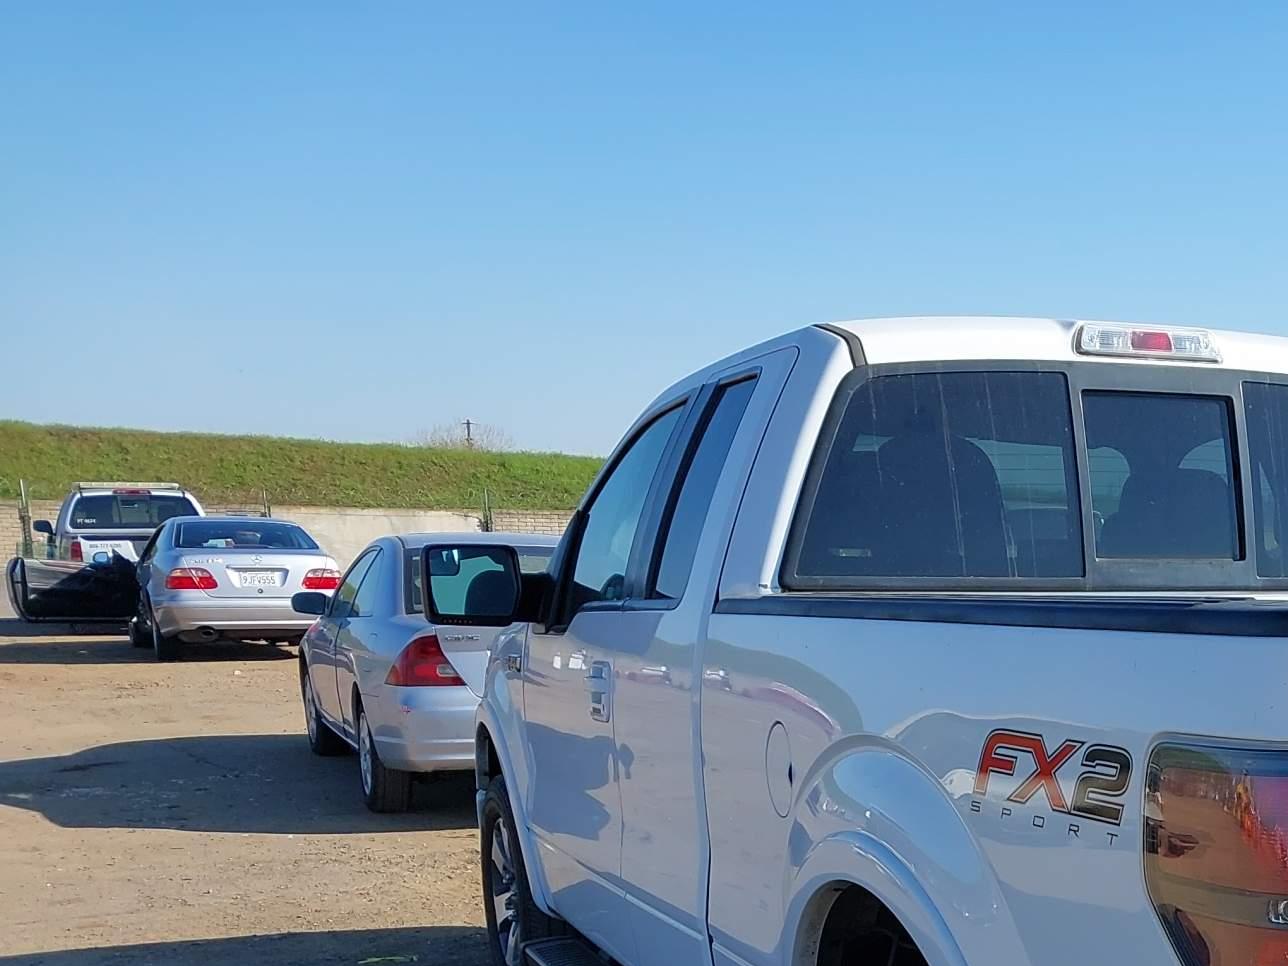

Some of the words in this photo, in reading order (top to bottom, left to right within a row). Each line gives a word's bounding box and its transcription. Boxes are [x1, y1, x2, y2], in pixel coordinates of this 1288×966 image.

[242, 575, 276, 585] 9JFV555
[973, 728, 1134, 826] FX2
[970, 800, 1119, 846] SPORT
